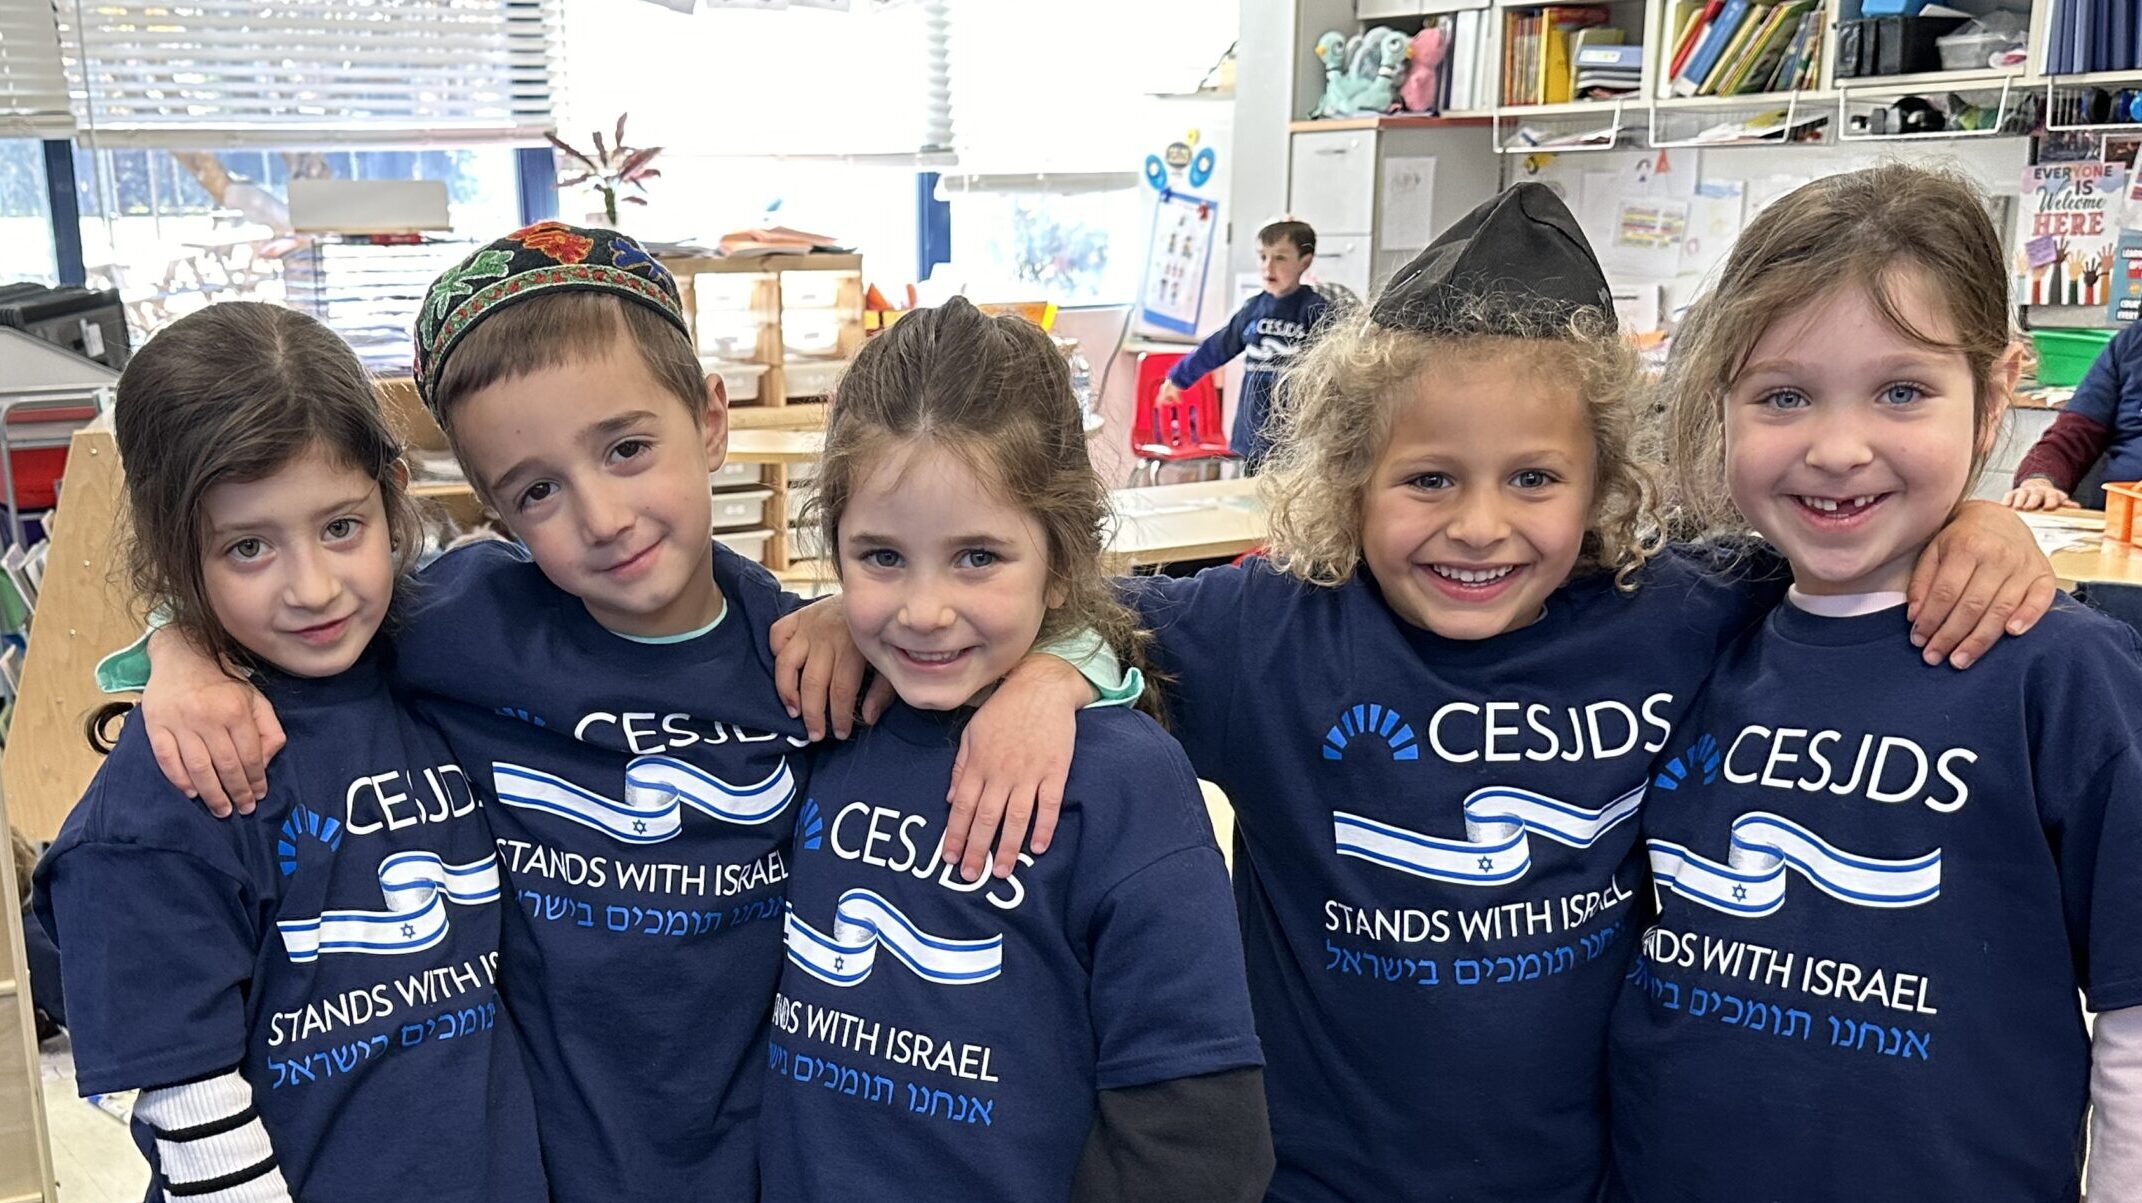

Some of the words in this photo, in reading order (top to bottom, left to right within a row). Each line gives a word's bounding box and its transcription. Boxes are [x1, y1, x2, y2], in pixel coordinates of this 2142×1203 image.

[2034, 165, 2113, 179] EVERYONE
[2036, 178, 2106, 212] Welcome
[2075, 180, 2093, 195] IS
[2031, 211, 2104, 236] HERE
[1429, 692, 1673, 763] CESJDS
[1724, 725, 1979, 813] CESJDS
[615, 861, 705, 895] WITH
[715, 849, 789, 896] ISRAEL
[1324, 900, 1451, 943] STANDS
[1458, 899, 1553, 943] WITH
[1325, 938, 1440, 985] בישראל
[1704, 935, 1793, 989] WITH
[1802, 957, 1938, 1015] ISRAEL
[268, 985, 394, 1047] STANDS
[394, 962, 482, 1008] WITH
[1689, 986, 1812, 1041] תומכים
[807, 1004, 881, 1056] WITH
[885, 1026, 999, 1083] ISRAEL
[1828, 1015, 1931, 1061] אנחנו
[794, 1053, 895, 1105] תומכים
[907, 1082, 994, 1127] אנחנו
